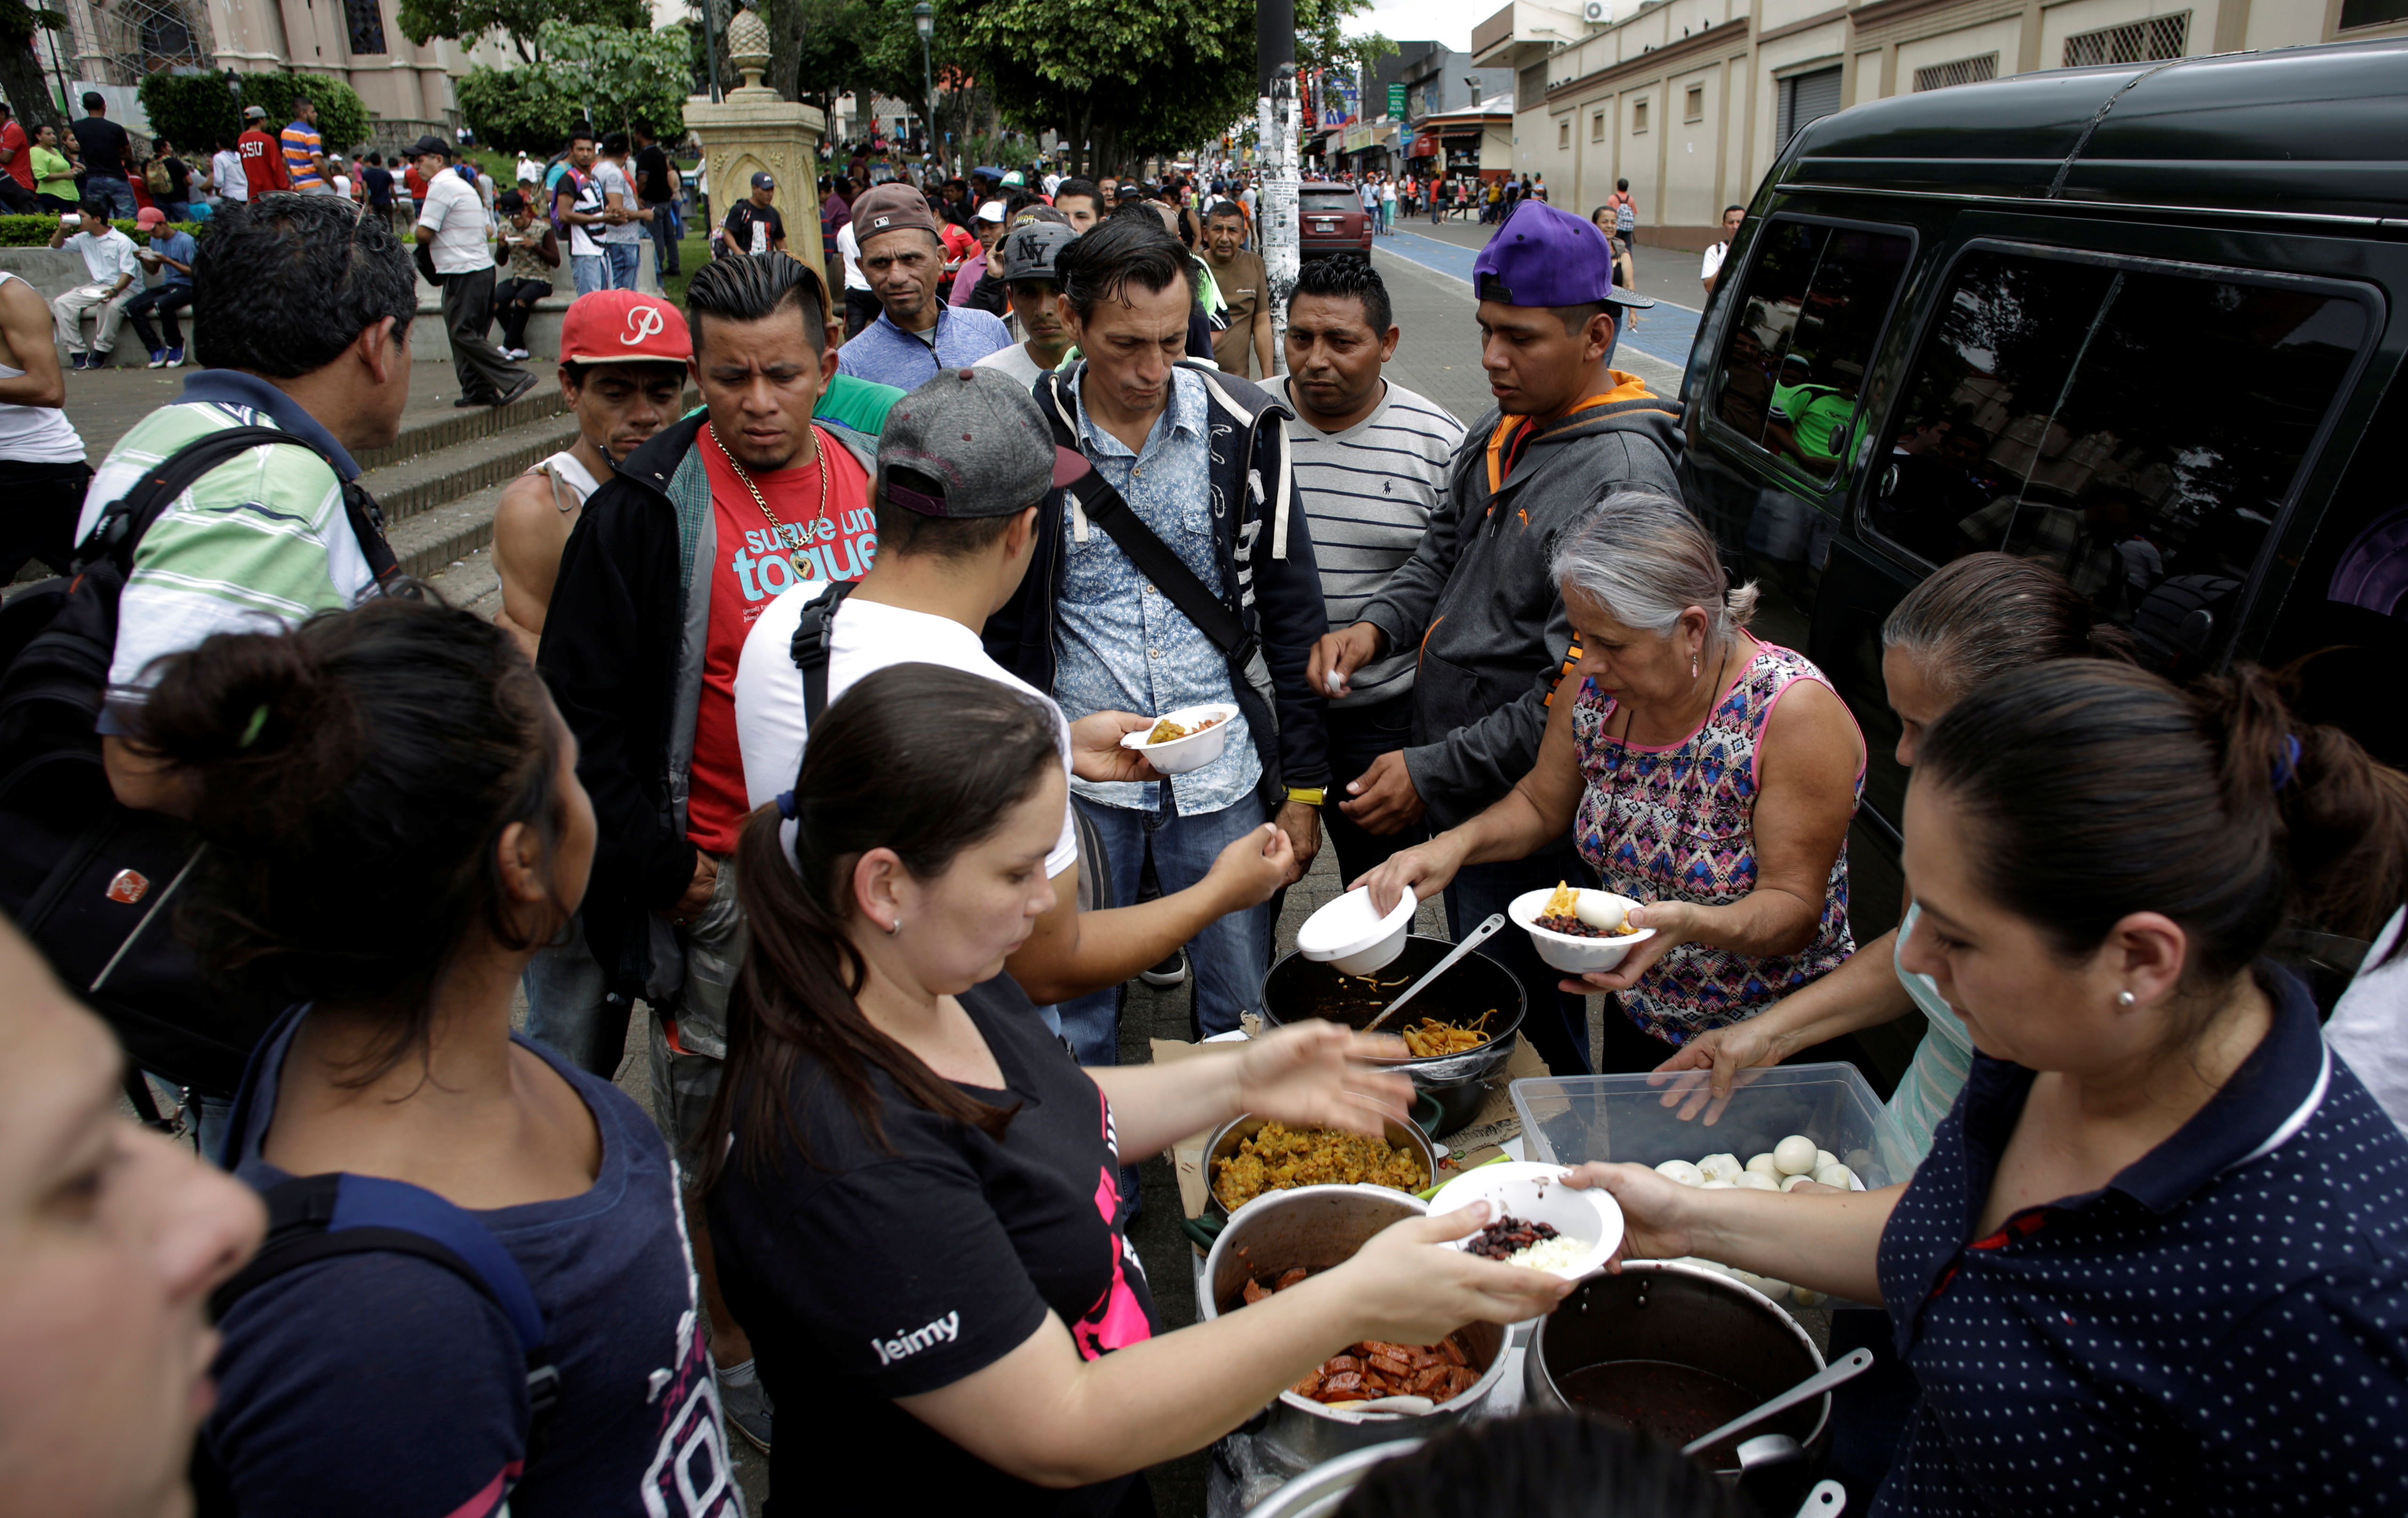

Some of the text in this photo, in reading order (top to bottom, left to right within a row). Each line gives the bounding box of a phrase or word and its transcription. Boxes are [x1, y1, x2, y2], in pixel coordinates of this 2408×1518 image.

[1016, 233, 1050, 267] NY
[619, 305, 664, 346] P
[744, 506, 877, 554] suave un
[732, 533, 878, 602] toque
[871, 1310, 960, 1365] Jeimy
